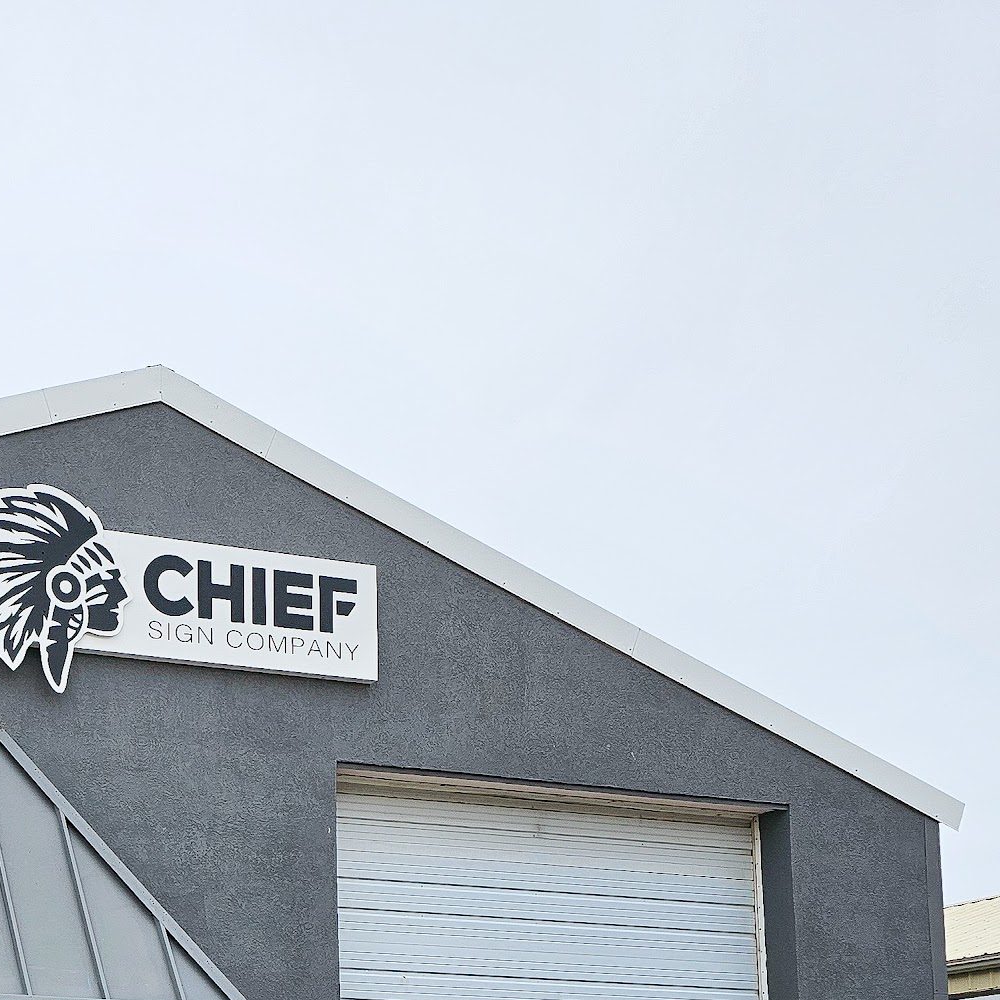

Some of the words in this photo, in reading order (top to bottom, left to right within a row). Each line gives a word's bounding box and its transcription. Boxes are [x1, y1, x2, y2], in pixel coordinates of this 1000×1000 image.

[143, 554, 358, 634] CHIEF
[148, 620, 214, 646] SIGN
[226, 629, 359, 661] COMPANY
